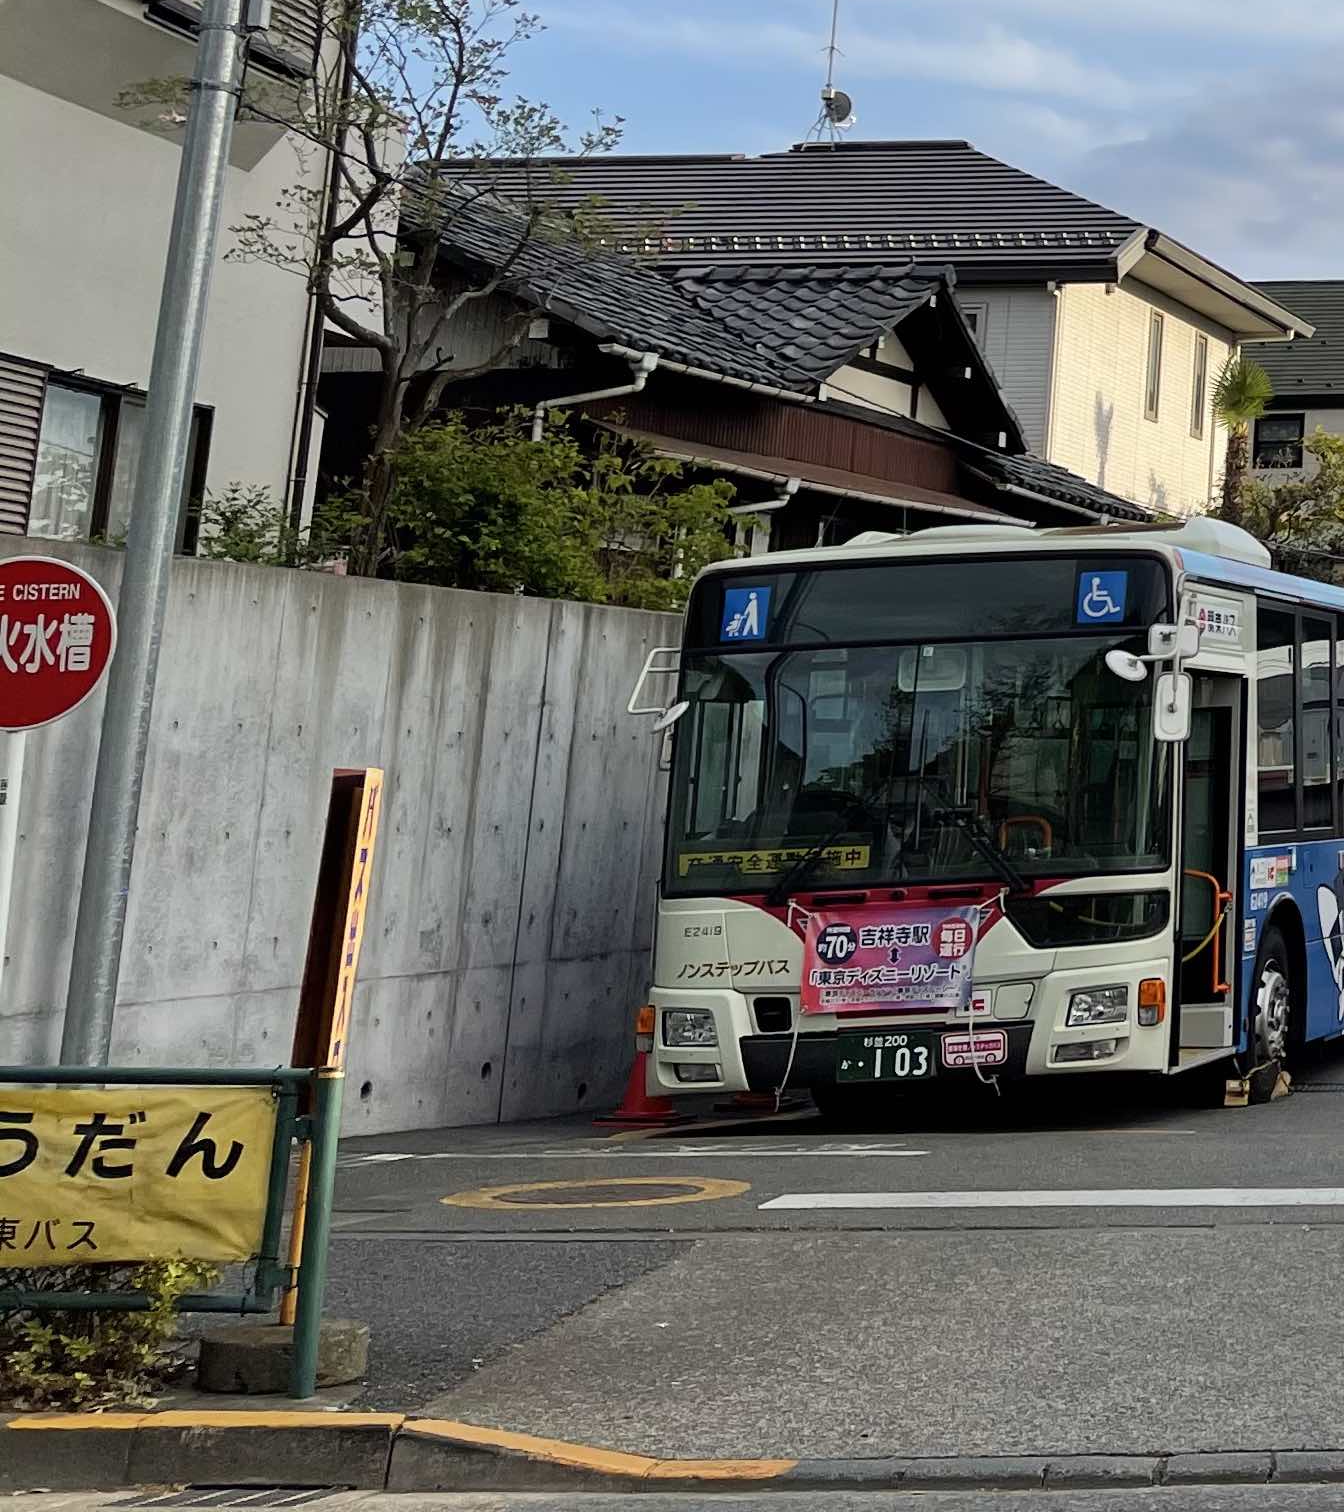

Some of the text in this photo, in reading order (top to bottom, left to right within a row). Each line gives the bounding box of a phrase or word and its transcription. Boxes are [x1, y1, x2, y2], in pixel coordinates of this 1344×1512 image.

[12, 583, 81, 601] CISTERN
[684, 925, 722, 938] E2419
[860, 924, 931, 947] 吉祥寺駅
[677, 959, 790, 980] ノンステップバス
[0, 1111, 245, 1179] うだん
